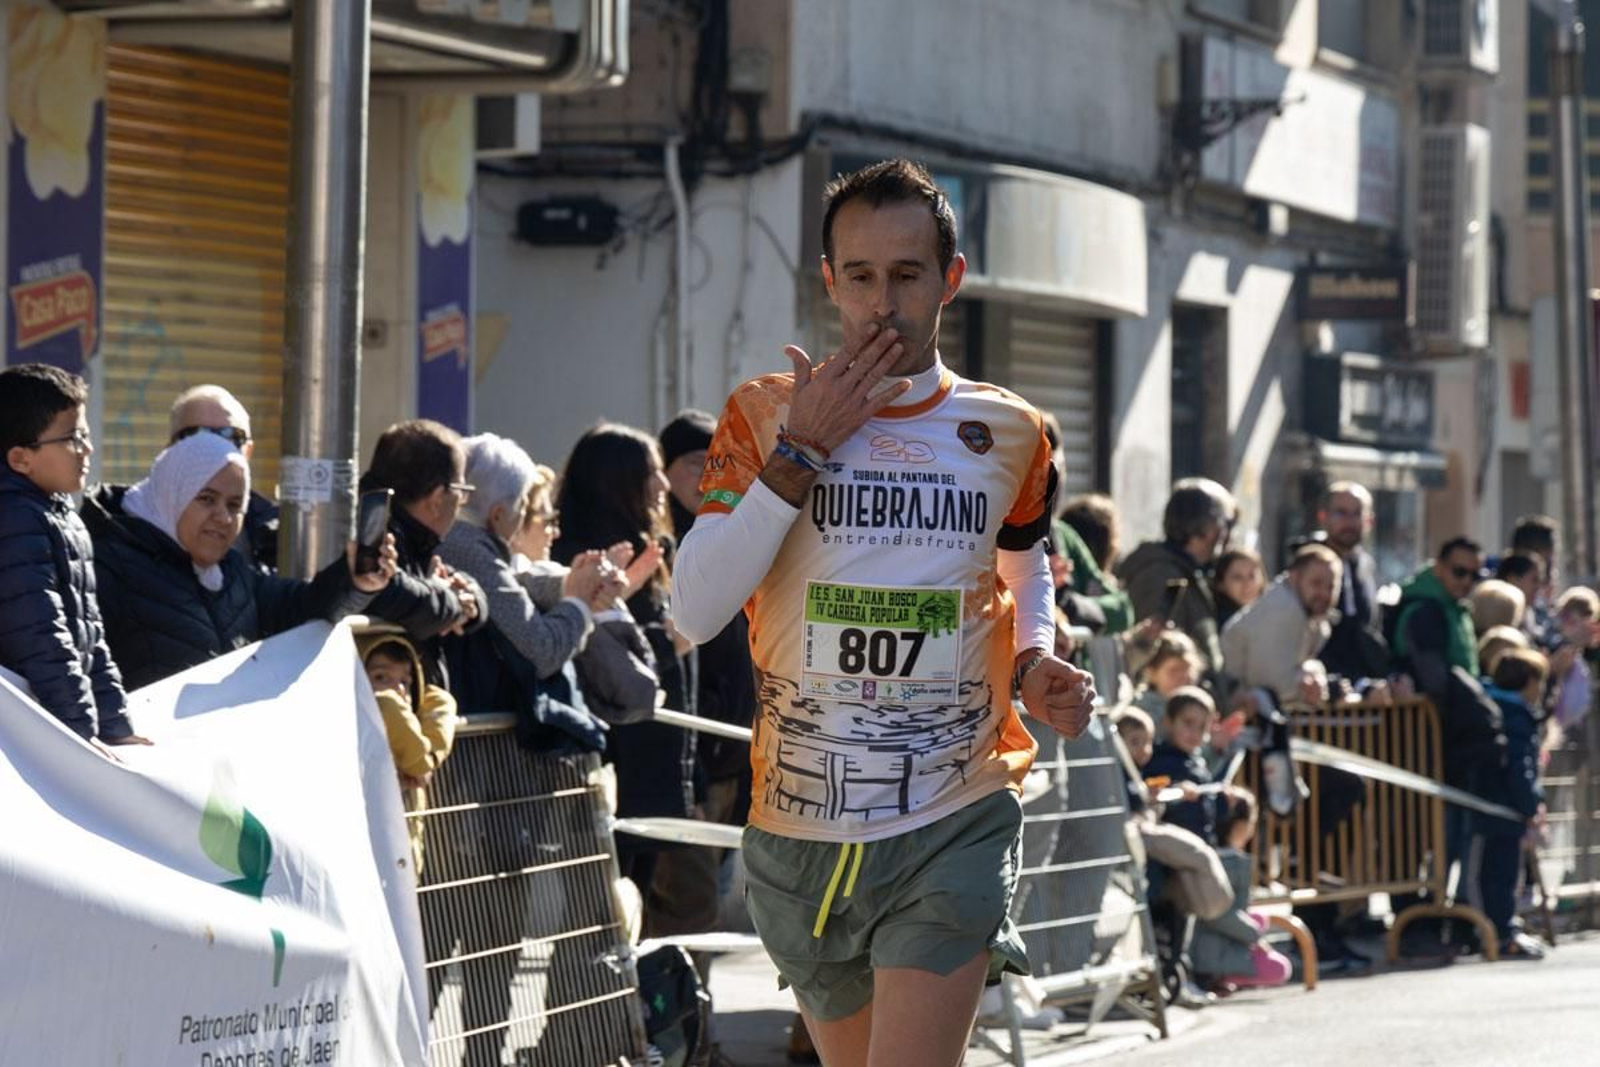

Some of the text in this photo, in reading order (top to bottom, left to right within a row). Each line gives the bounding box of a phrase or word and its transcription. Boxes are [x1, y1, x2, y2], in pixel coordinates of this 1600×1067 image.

[853, 469, 957, 486] SUBIDA AL PANTANO DEL
[811, 483, 988, 535] QUIEBRAJANO
[835, 588, 854, 603] SAN
[858, 590, 885, 606] JUAN
[888, 592, 918, 608] BOSCO
[816, 602, 910, 624] IV CARRERA POPULAR
[838, 627, 927, 678] 807
[178, 1008, 258, 1044] Patronato
[263, 994, 340, 1032] Municipal
[280, 1041, 300, 1067] de
